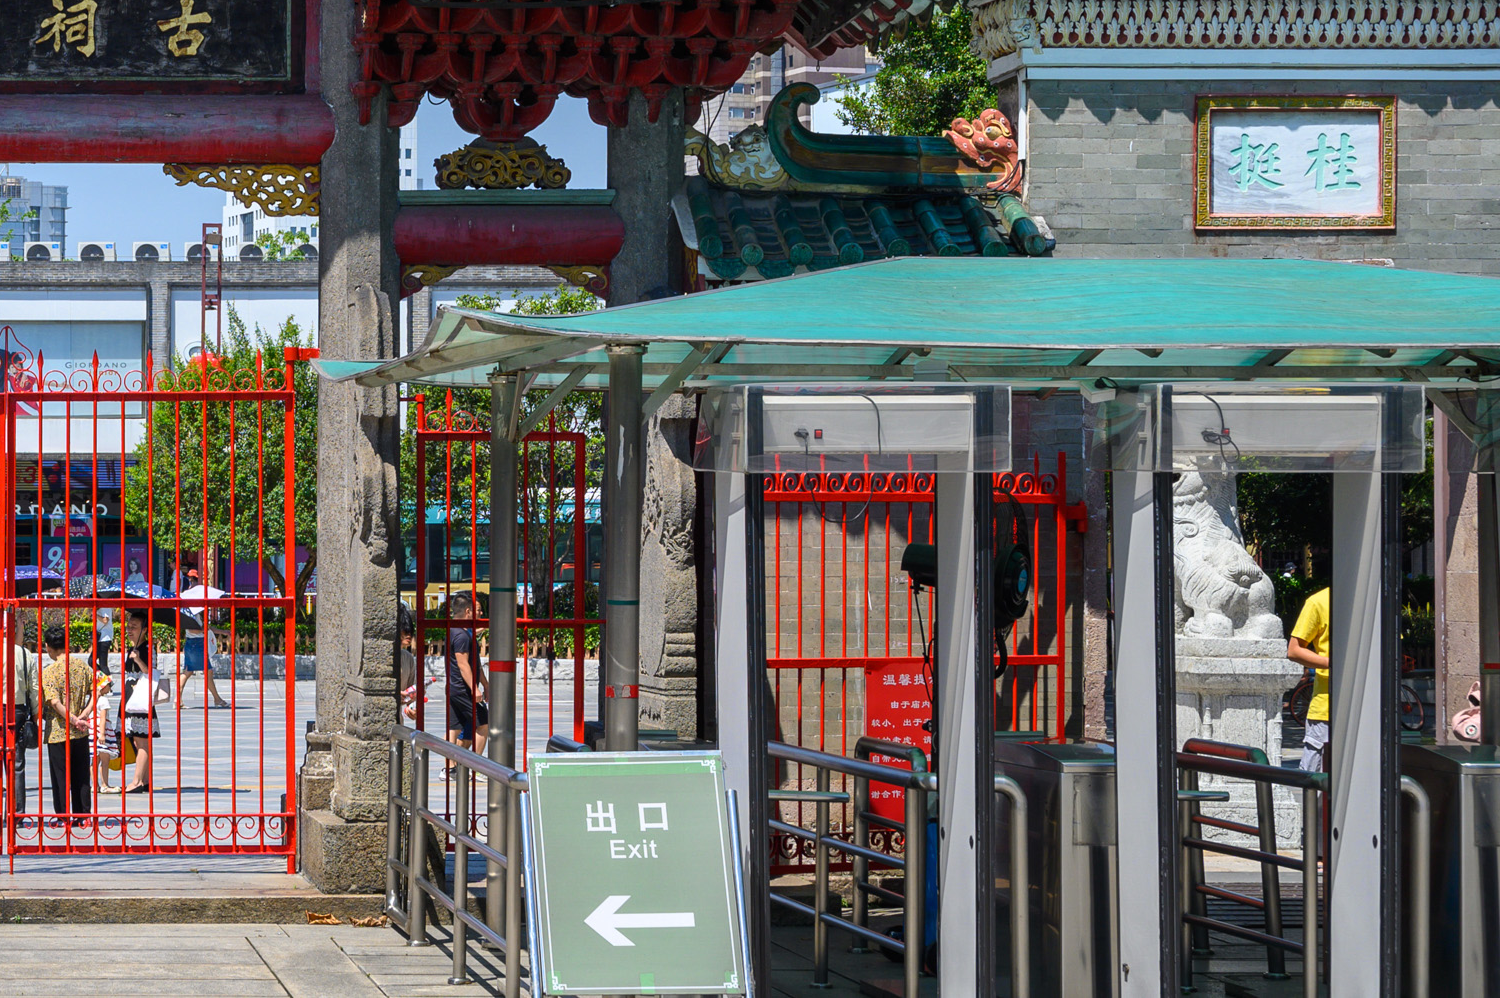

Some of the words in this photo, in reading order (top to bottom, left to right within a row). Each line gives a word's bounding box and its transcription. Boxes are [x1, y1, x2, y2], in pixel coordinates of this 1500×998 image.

[890, 700, 930, 709] 由于庙内
[586, 800, 669, 834] 出口
[609, 839, 659, 859] Exit
